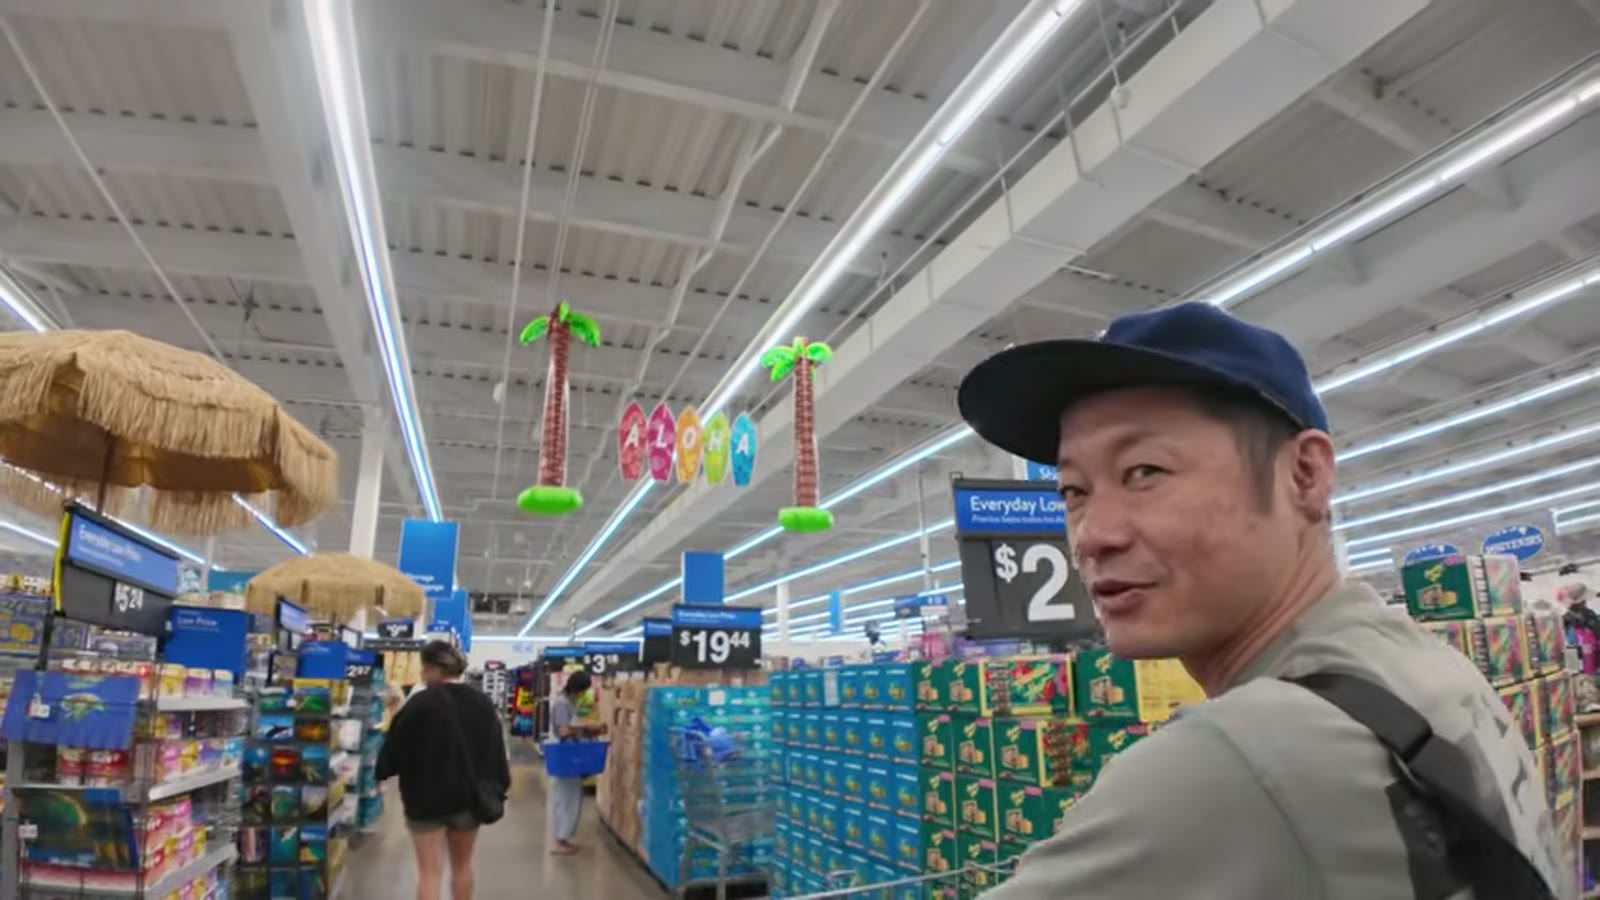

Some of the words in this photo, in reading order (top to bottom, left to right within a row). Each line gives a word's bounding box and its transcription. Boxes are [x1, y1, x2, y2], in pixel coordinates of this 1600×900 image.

[623, 423, 749, 455] ALOHA
[970, 496, 1036, 516] Everyday
[1039, 497, 1067, 512] Low
